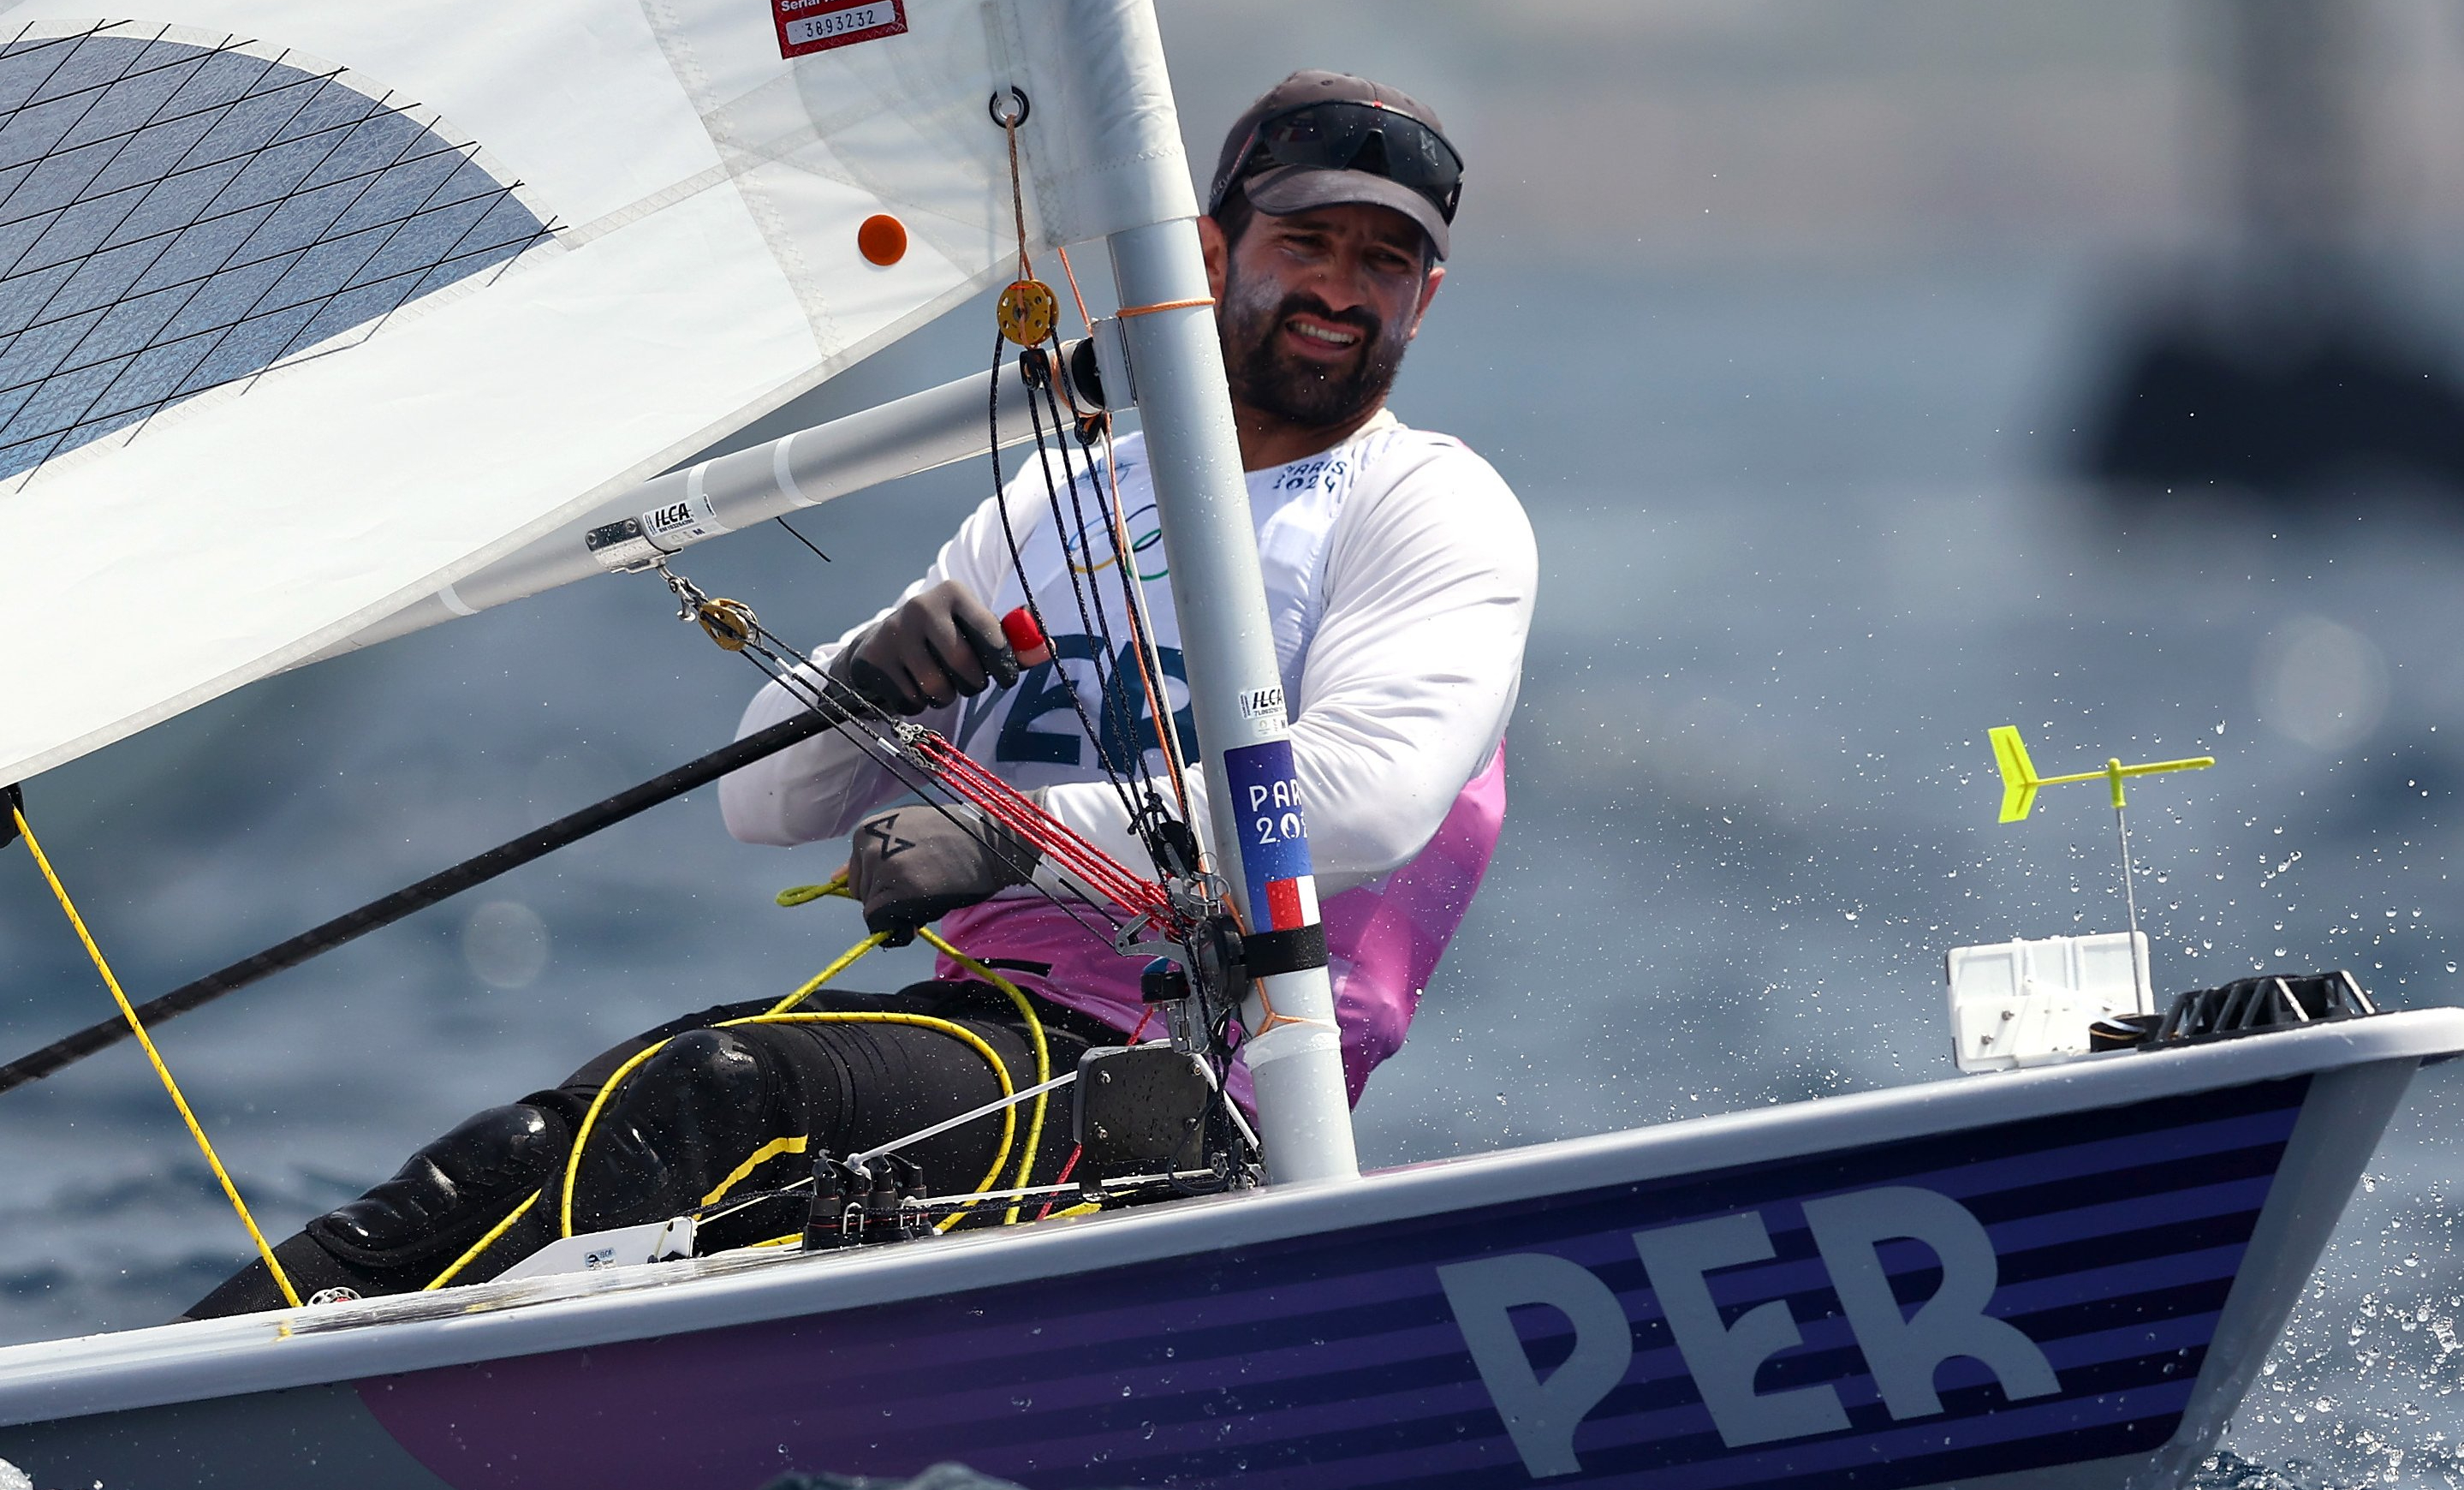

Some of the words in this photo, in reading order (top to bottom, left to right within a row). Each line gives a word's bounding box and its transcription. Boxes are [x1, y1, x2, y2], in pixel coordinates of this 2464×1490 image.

[805, 9, 875, 38] 3893232
[1285, 460, 1348, 475] PARIS
[655, 502, 691, 527] ILCA
[1252, 688, 1283, 710] ILCA
[1436, 1185, 2062, 1479] PER
